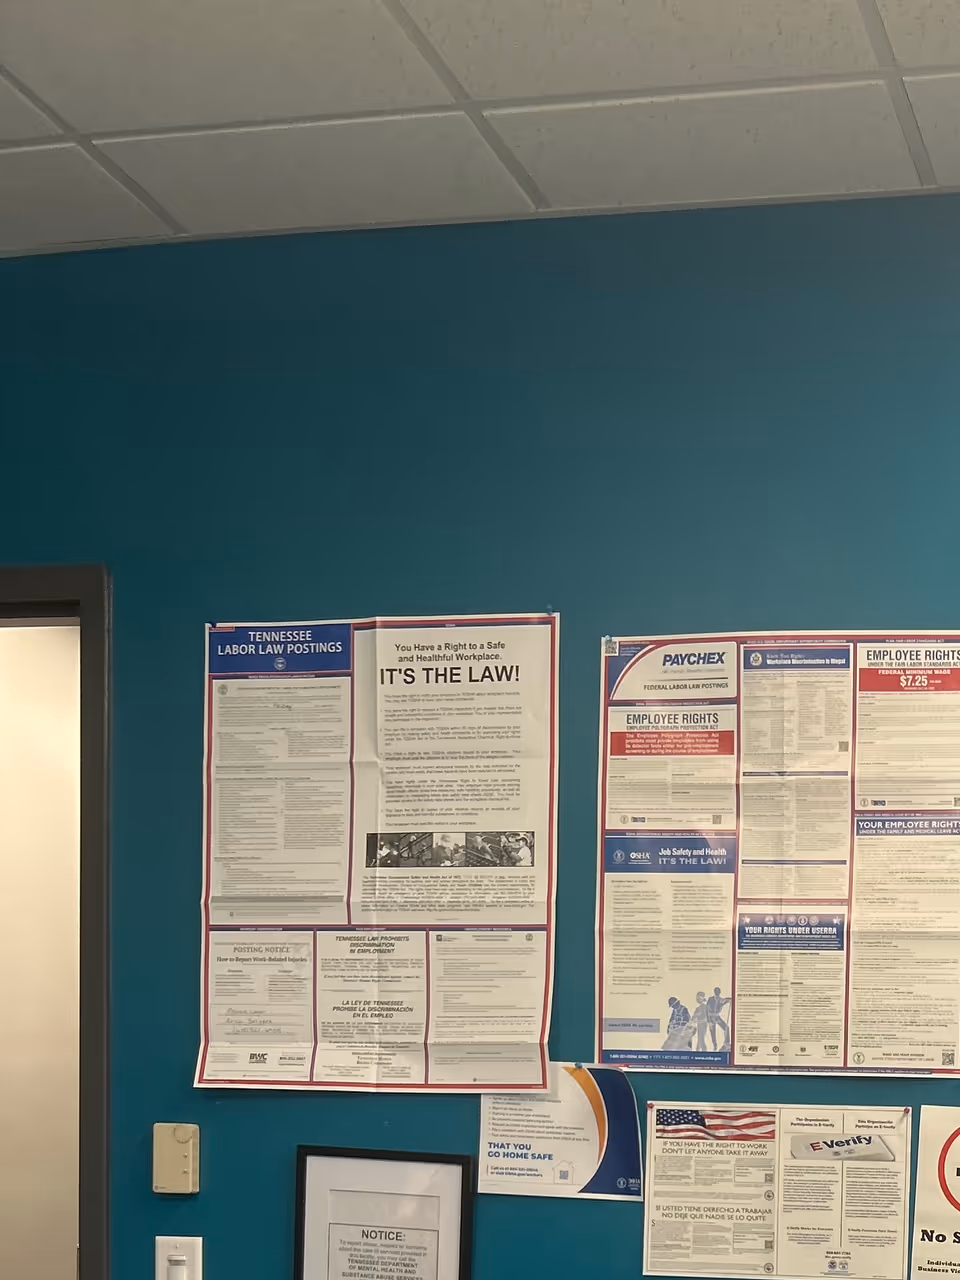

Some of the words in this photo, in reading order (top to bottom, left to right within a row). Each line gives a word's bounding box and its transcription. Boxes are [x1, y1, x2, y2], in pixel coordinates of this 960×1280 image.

[248, 630, 312, 642] TENNESSEE
[218, 644, 256, 655] LABOR
[258, 644, 284, 655] LAW
[287, 642, 342, 654] POSTINGS
[394, 643, 412, 652] You
[413, 643, 435, 652] Have
[444, 642, 467, 652] Right
[468, 643, 477, 651] to
[486, 641, 506, 650] Safe
[398, 655, 414, 663] and
[416, 654, 454, 662] Healthful
[455, 653, 502, 662] Workplace.
[662, 652, 726, 667] PAYCHEX
[866, 649, 921, 661] EMPLOYEE
[380, 668, 416, 685] IT'S
[422, 667, 462, 684] THE
[468, 665, 520, 683] LAW!
[900, 675, 928, 688] $7.25
[626, 713, 679, 725] EMPLOYEE
[682, 712, 719, 724] RIGHTS
[858, 821, 883, 829] YOUR
[885, 821, 930, 829] EMPLOYEE
[658, 848, 672, 856] Job
[672, 848, 692, 857] Safety
[692, 848, 705, 856] and
[705, 848, 727, 856] Health
[745, 926, 762, 934] YOUR
[763, 926, 787, 934] RIGHTS
[788, 926, 811, 935] UNDER
[488, 1142, 511, 1150] THAT
[512, 1143, 531, 1151] YOU
[502, 1151, 529, 1160] HOME
[531, 1152, 554, 1161] SAFE
[696, 1148, 724, 1156] ANYONE
[703, 1206, 735, 1214] DERECHO
[740, 1207, 772, 1215] TRABAJAR
[361, 1229, 406, 1242] NOTICE:
[920, 1229, 947, 1243] No
[348, 1258, 380, 1266] TENNESSEE
[381, 1260, 418, 1268] DEPARTMENT
[341, 1271, 375, 1280] SUBSTANCE
